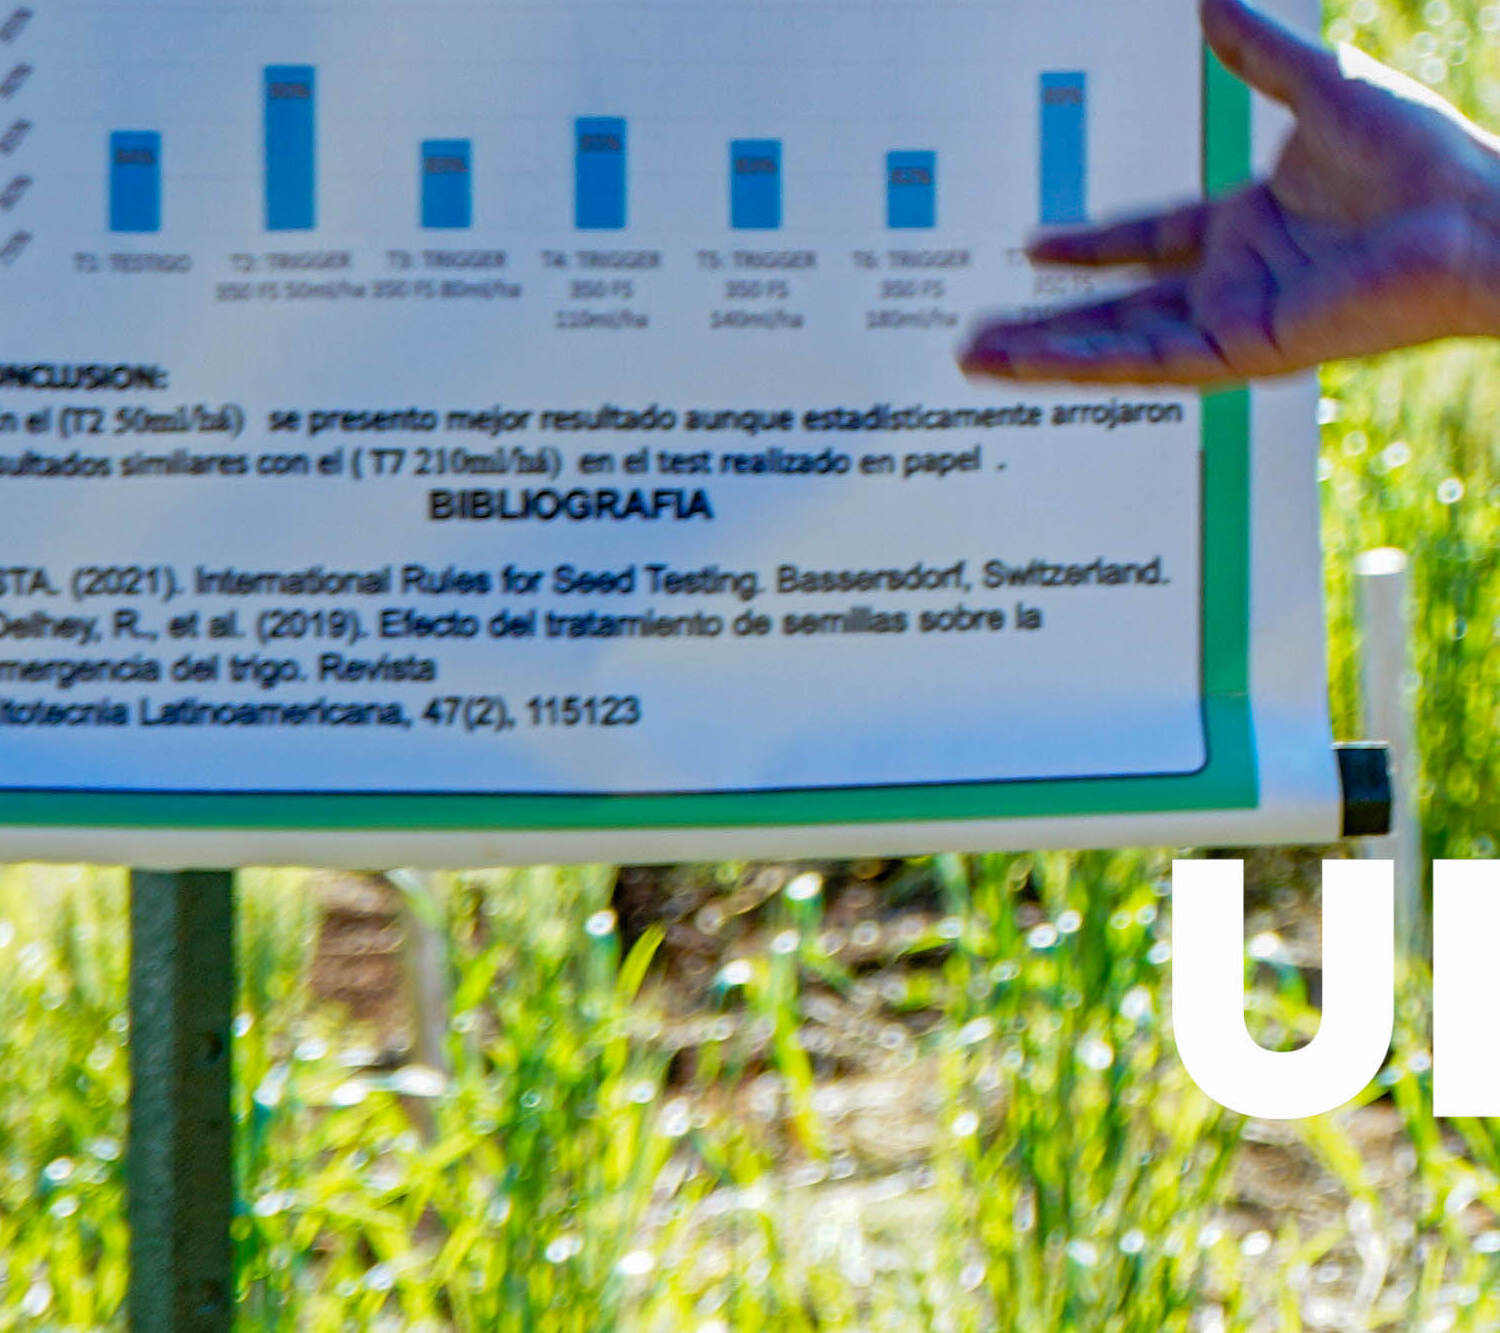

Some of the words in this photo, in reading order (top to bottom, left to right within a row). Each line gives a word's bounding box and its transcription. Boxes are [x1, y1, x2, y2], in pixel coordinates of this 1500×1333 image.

[429, 487, 714, 522] BIBLIOGRAFIA
[196, 566, 391, 596] International
[402, 564, 492, 596] Rules
[501, 564, 544, 595] for
[553, 564, 636, 596] Seed
[645, 563, 762, 602] Testing.
[984, 557, 1168, 589] Switzerland.
[171, 654, 219, 683] del
[229, 654, 306, 690] trigo.
[319, 652, 436, 683] Revista
[140, 698, 412, 729] Latinoamericana,
[528, 695, 640, 727] 115123
